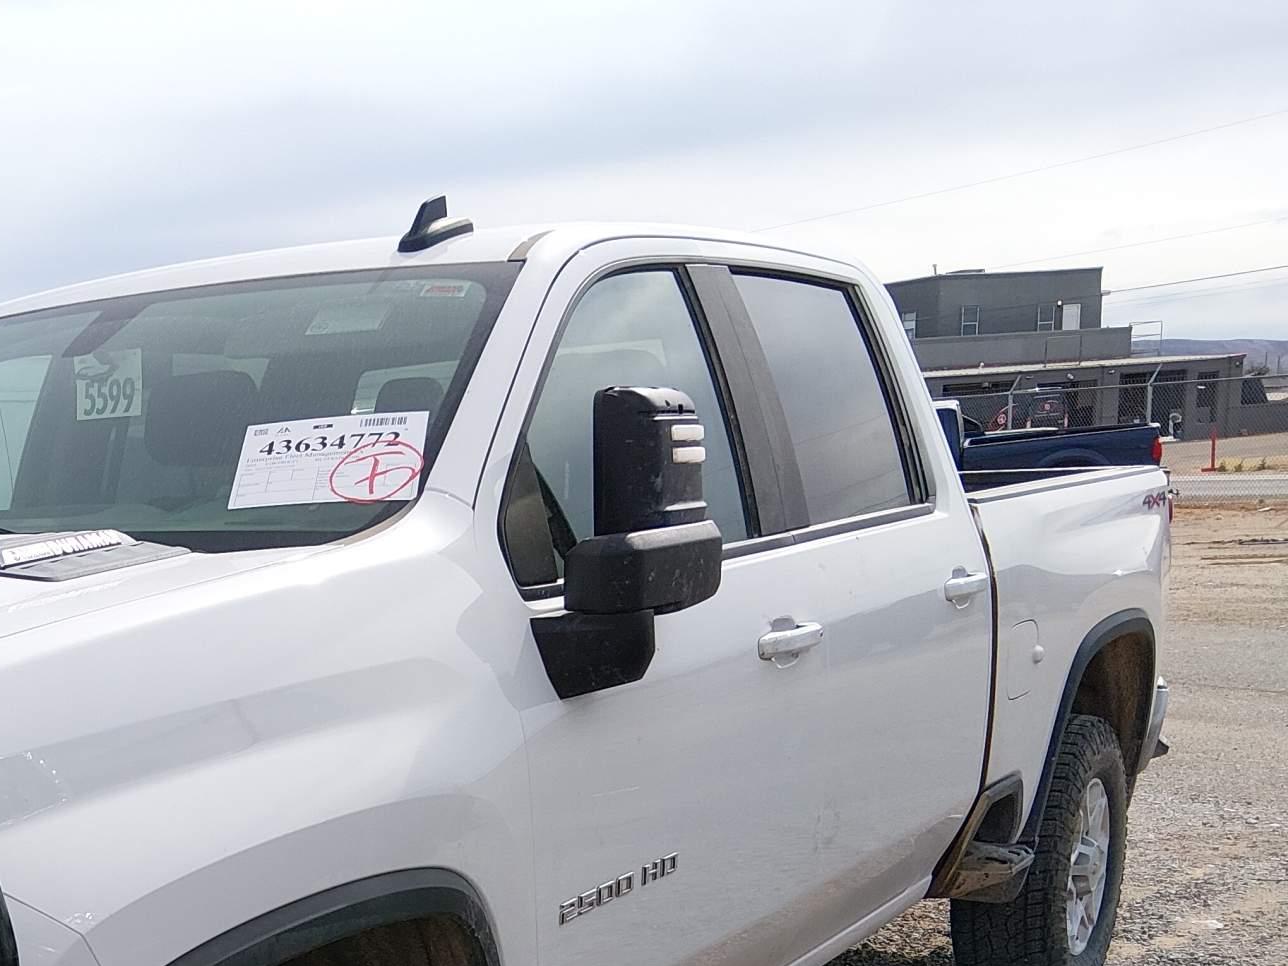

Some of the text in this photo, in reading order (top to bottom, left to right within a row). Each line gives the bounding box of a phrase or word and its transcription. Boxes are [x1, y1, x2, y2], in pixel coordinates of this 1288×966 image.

[83, 377, 135, 416] 5599
[259, 431, 401, 456] 43634772
[559, 851, 679, 926] 2500 HD
